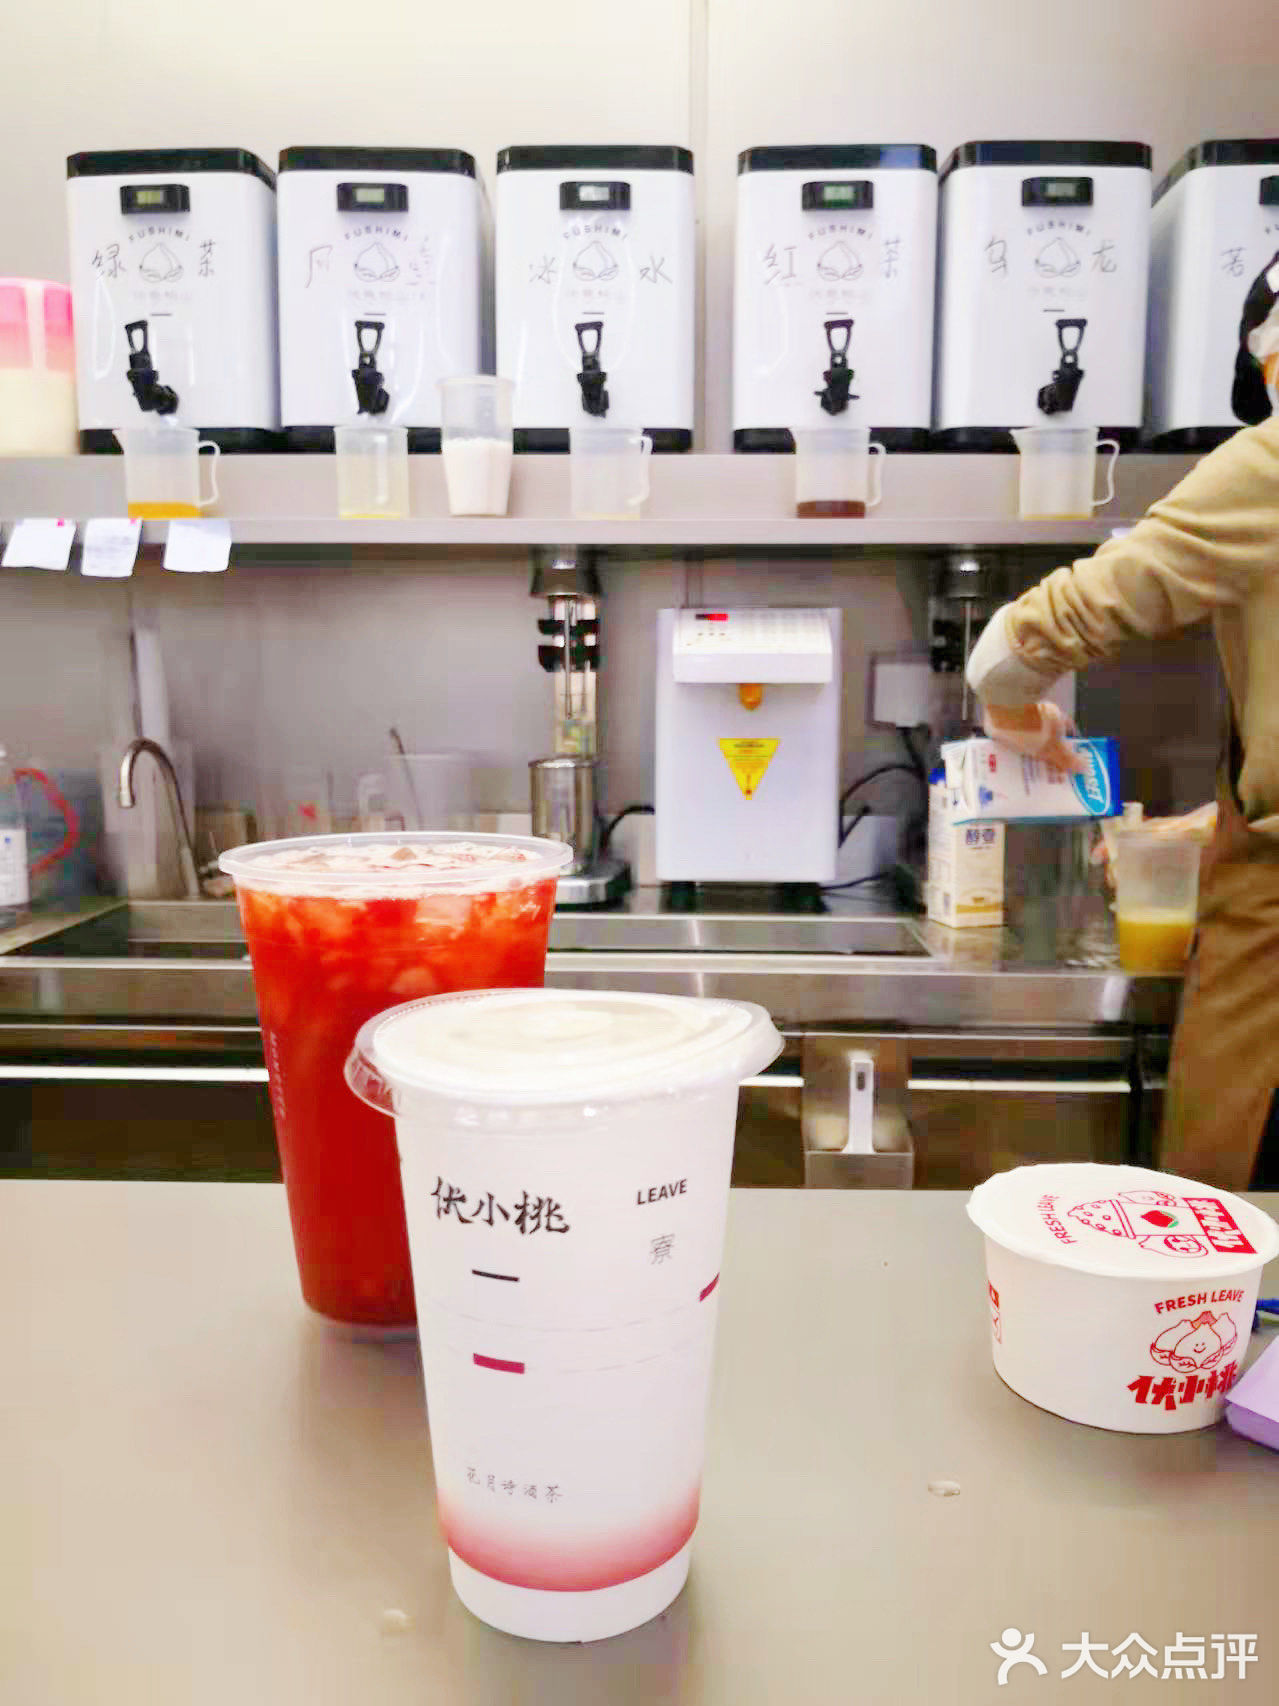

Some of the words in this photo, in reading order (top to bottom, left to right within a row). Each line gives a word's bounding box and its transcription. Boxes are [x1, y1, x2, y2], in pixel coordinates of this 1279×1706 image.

[639, 254, 674, 284] 水
[762, 243, 803, 286] 红
[431, 1175, 570, 1235] 伏小桃
[636, 1178, 688, 1206] LEAVE
[1040, 1213, 1079, 1245] FRESH
[1154, 1292, 1208, 1315] FRESH
[1211, 1289, 1245, 1303] LEAVE
[1126, 1360, 1239, 1411] 伏小桃
